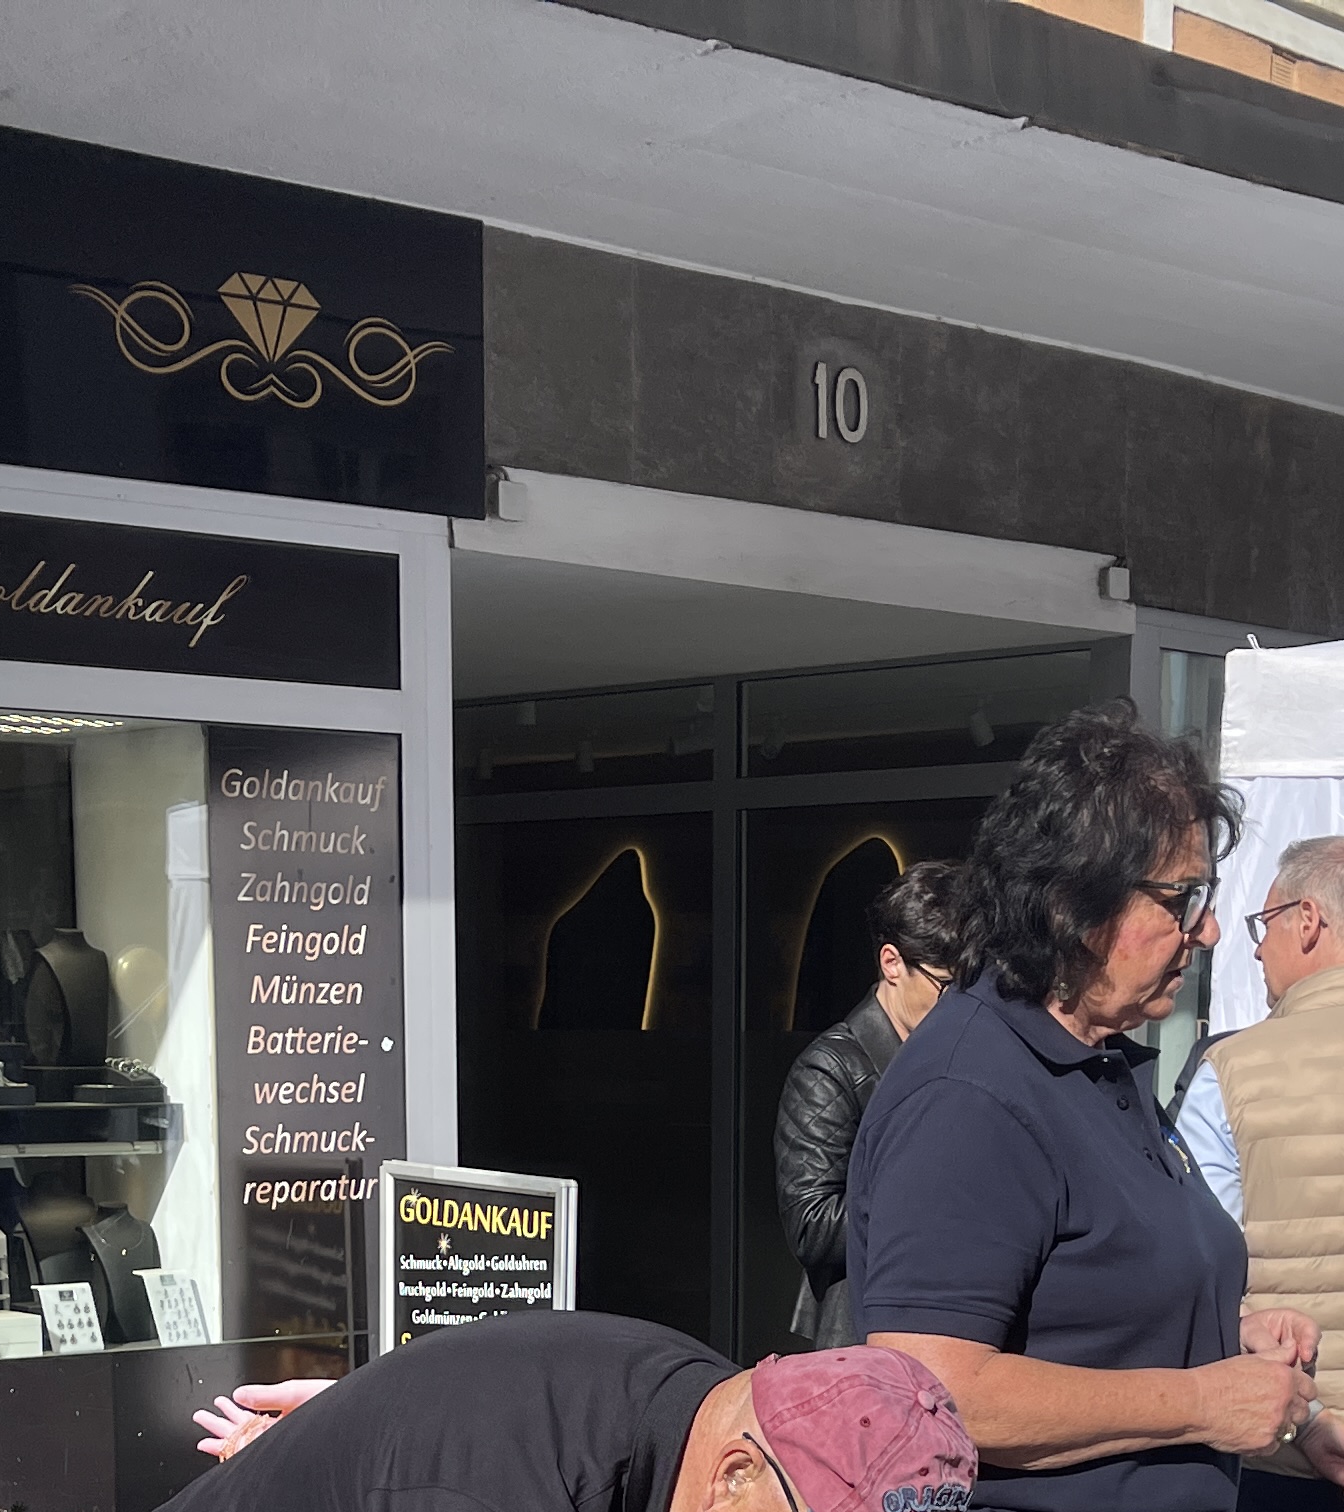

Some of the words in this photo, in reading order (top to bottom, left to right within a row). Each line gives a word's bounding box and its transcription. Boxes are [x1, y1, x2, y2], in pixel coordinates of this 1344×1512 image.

[814, 361, 868, 443] 10
[221, 768, 387, 812] Goldankauf
[240, 821, 367, 856] Schmuck
[237, 872, 371, 911] Zahngold
[245, 924, 368, 961] Feingold
[250, 975, 363, 1005] Münzen
[246, 1025, 369, 1055] Batterie-
[254, 1072, 366, 1104] wechsel
[242, 1123, 376, 1155] Schmuck-
[242, 1175, 378, 1210] reparatur
[399, 1194, 553, 1240] GOLDANKAUF
